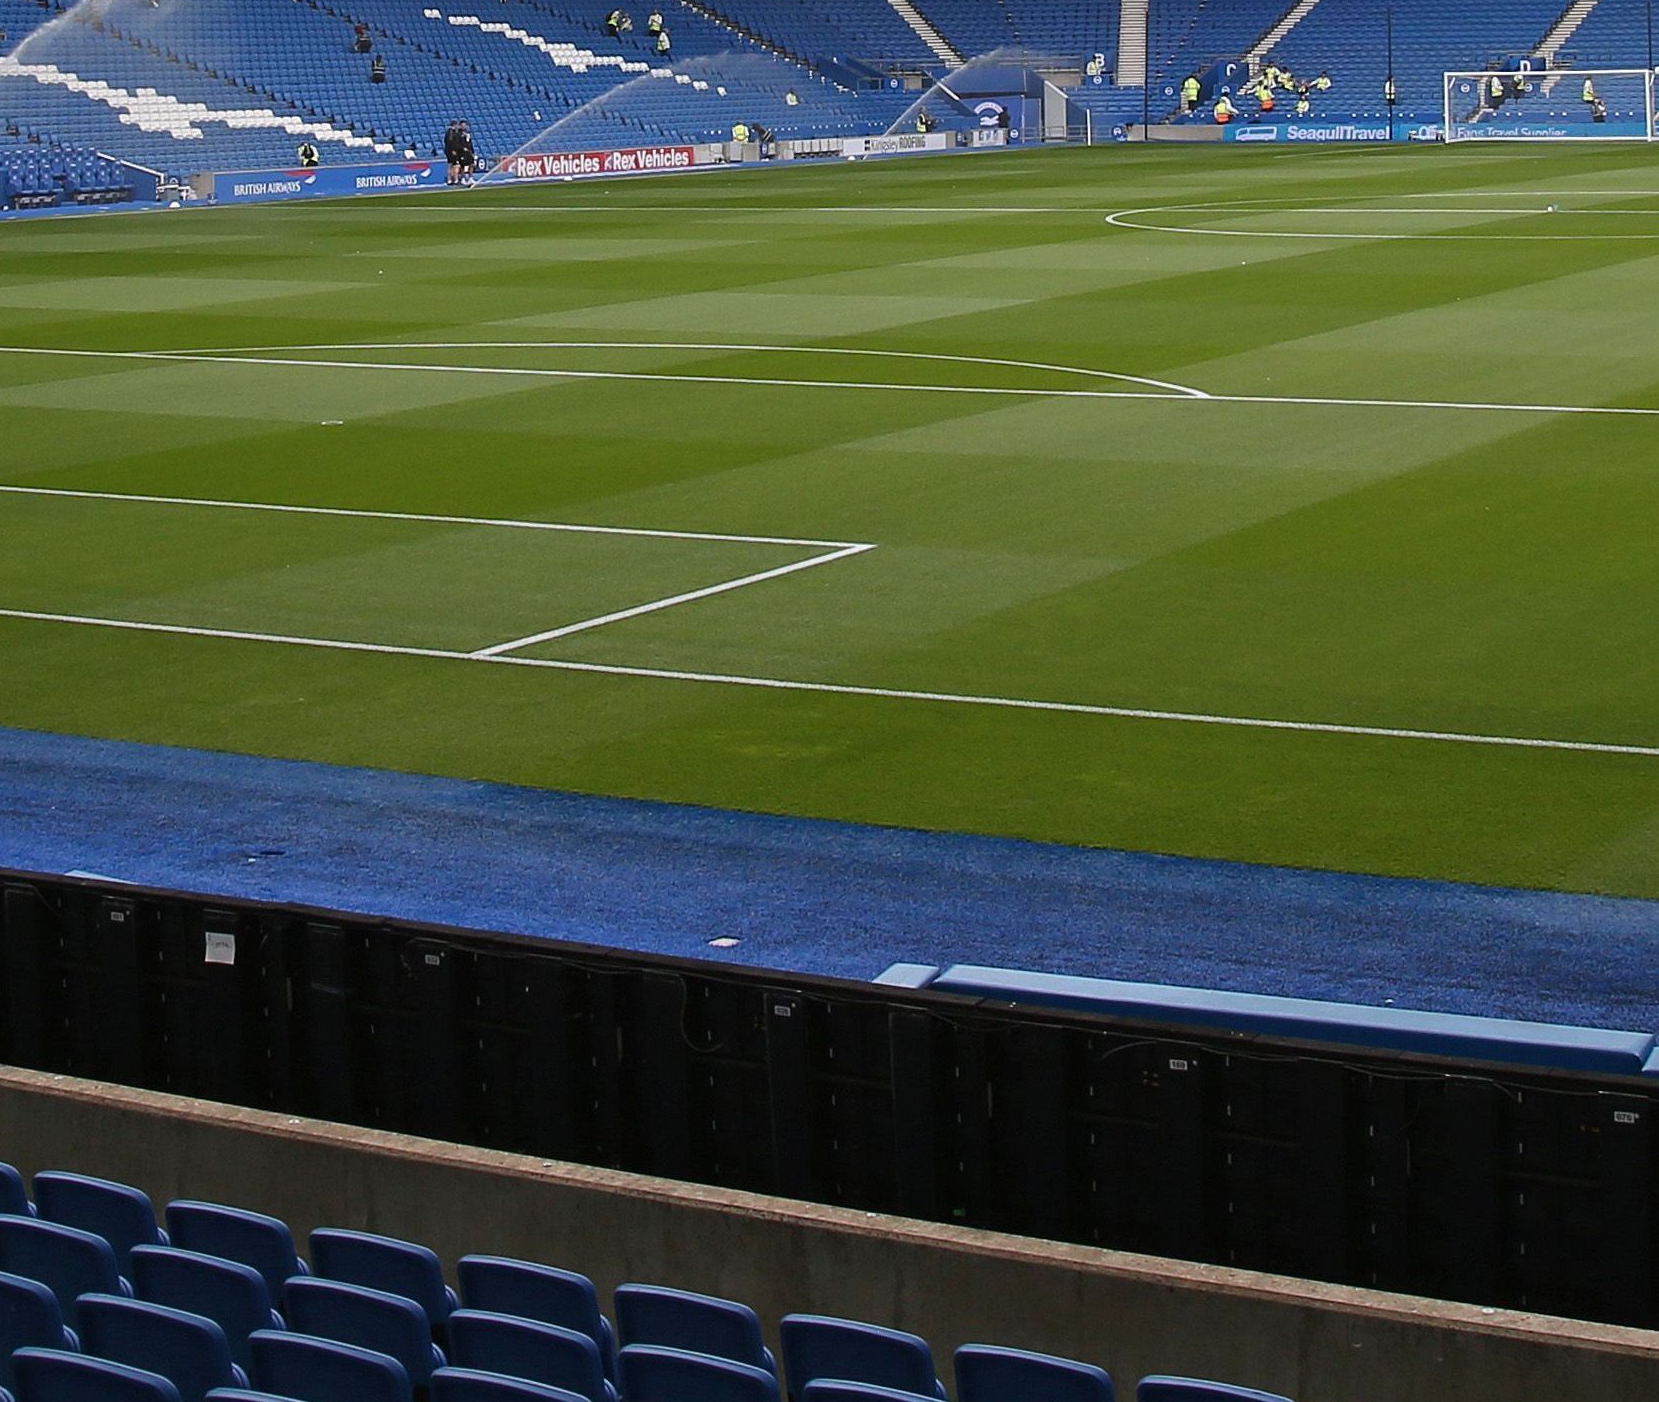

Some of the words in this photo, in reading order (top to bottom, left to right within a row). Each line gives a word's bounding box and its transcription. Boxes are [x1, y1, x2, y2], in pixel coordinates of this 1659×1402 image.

[1287, 125, 1390, 141] SeagullTravel
[518, 159, 542, 177] Rex
[543, 156, 600, 175] Vehicles
[613, 152, 637, 170] Rex
[637, 149, 689, 168] Vehicles
[234, 183, 267, 196] BRITISH
[267, 181, 301, 195] AIRWAYS
[356, 176, 386, 189] BRITISH
[386, 174, 417, 186] AIRWAYS
